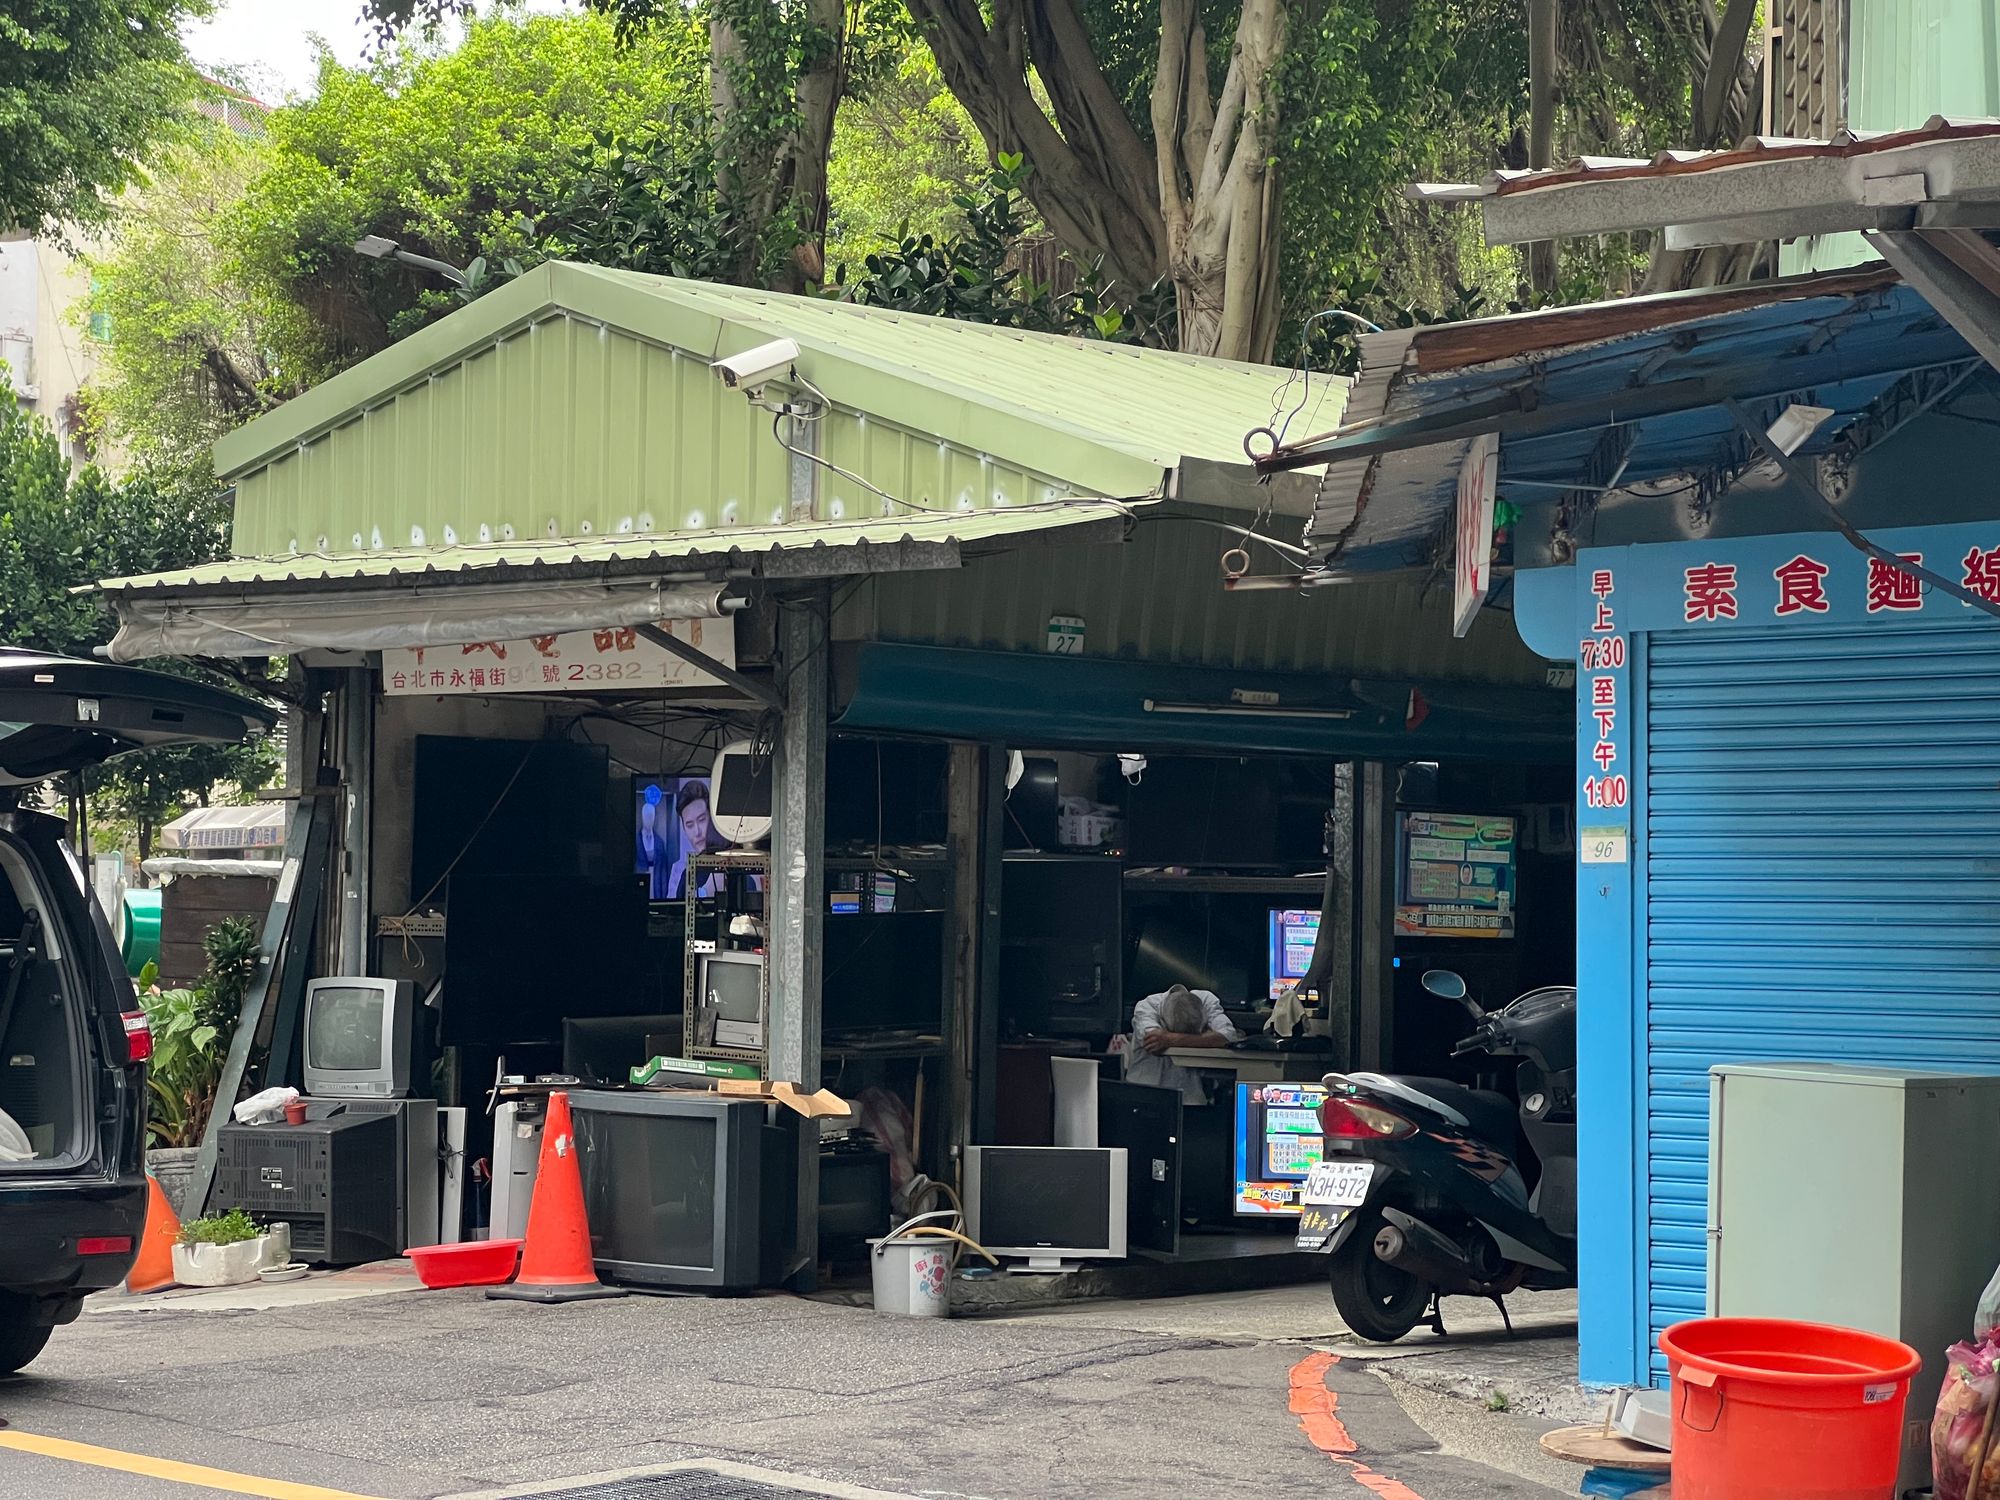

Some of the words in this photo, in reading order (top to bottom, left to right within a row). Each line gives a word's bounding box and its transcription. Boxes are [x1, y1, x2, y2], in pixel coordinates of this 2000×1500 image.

[1591, 569, 1614, 631] 早上
[1055, 635, 1077, 655] 27
[1581, 637, 1625, 670] 7:30
[1592, 676, 1616, 771] 至下午
[1583, 774, 1627, 808] 1:00
[1594, 841, 1614, 858] 96
